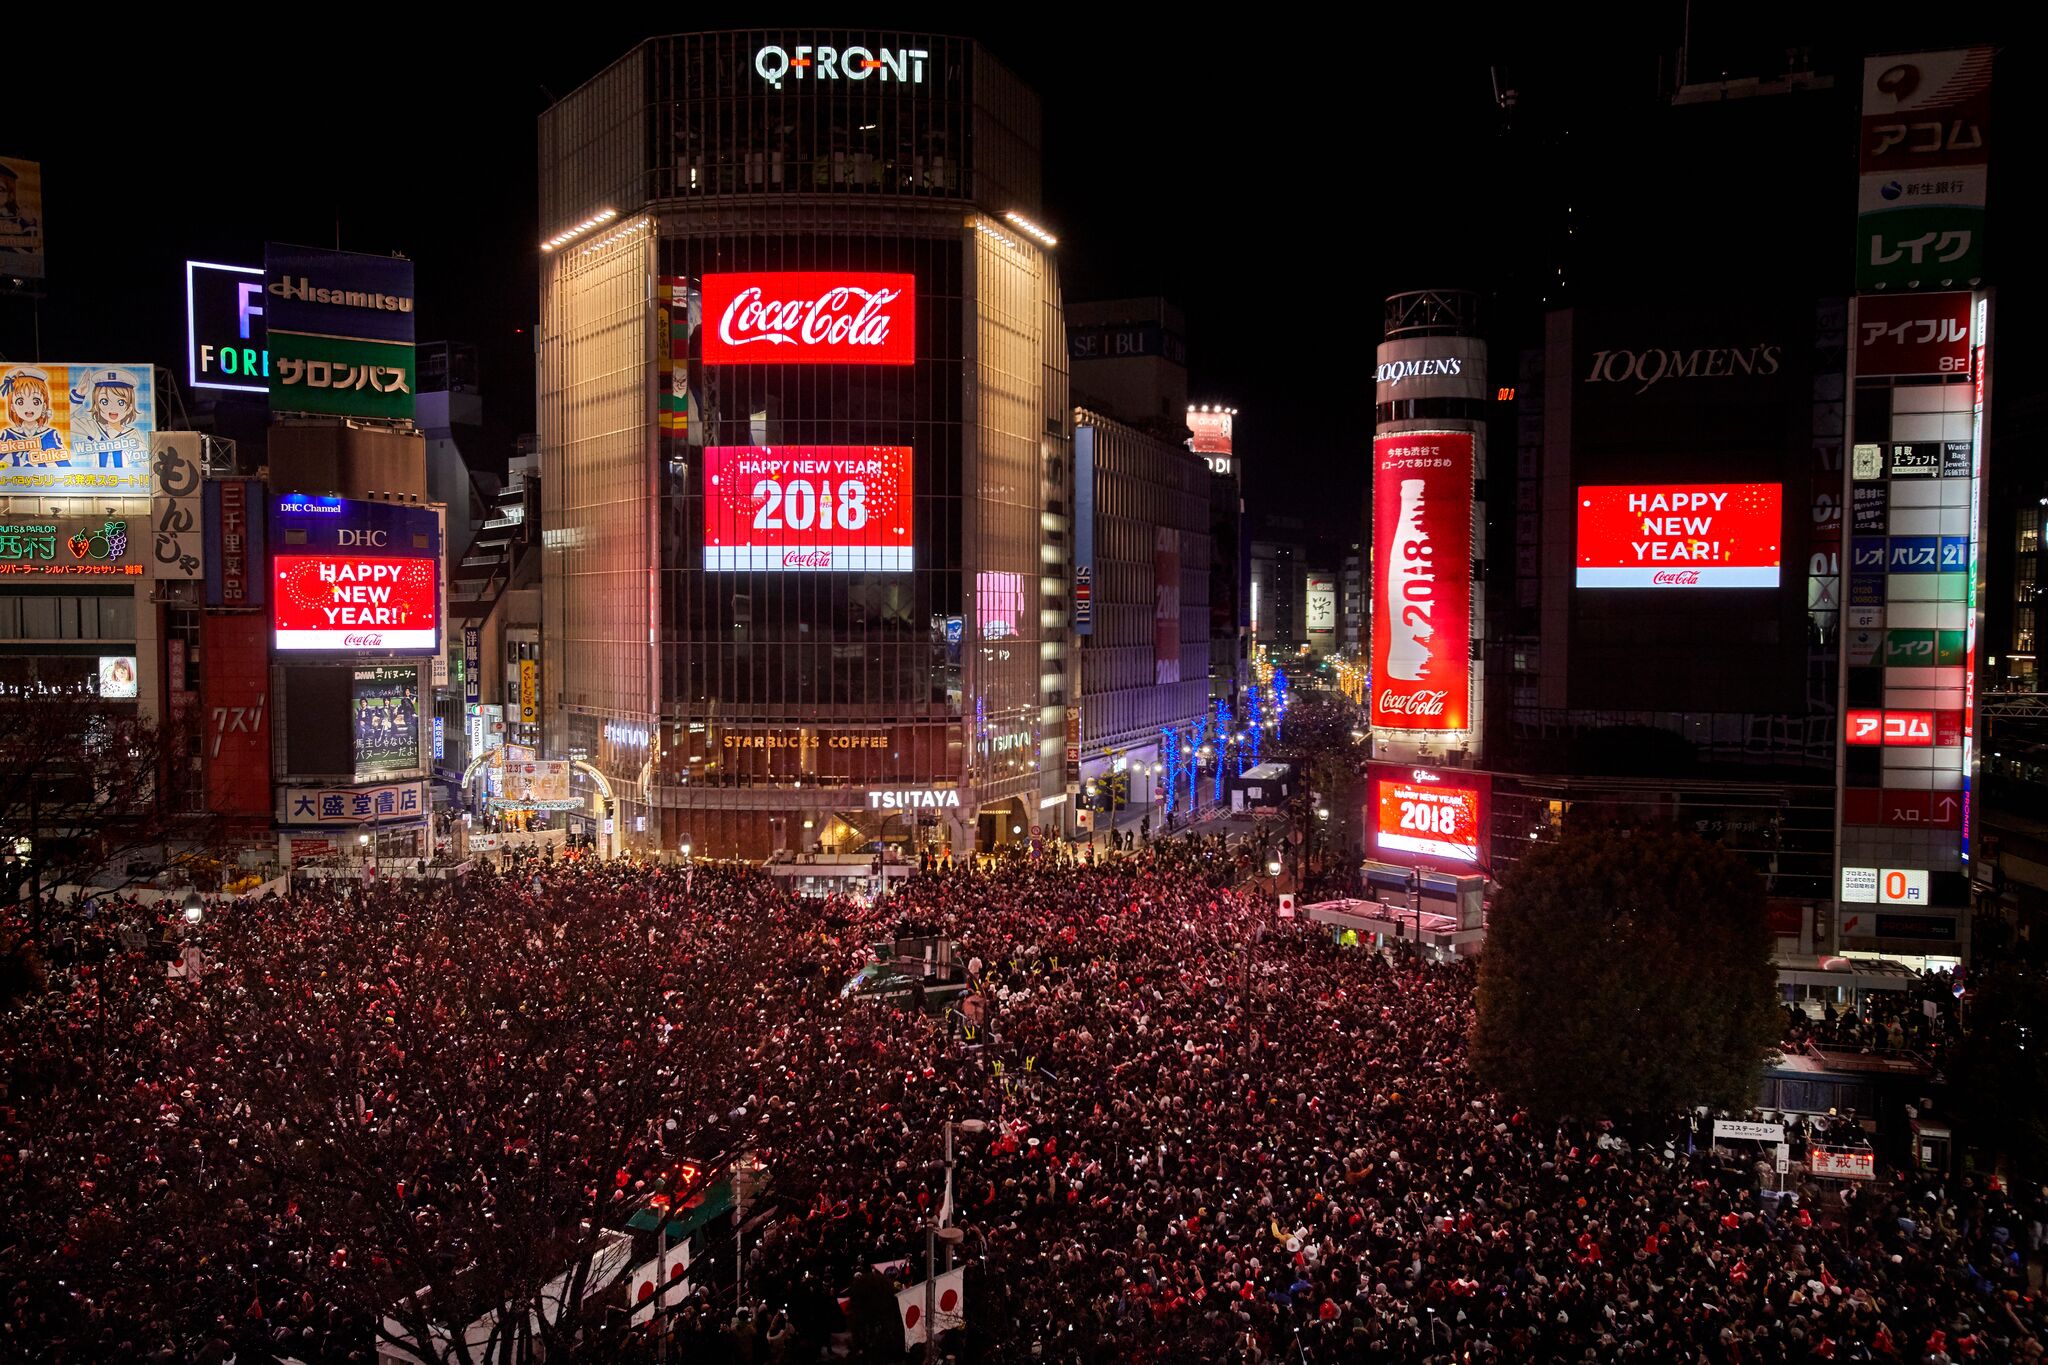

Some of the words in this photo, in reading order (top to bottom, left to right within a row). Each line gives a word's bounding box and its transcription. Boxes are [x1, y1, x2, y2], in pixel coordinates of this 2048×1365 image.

[755, 45, 928, 90] QFRONT
[1871, 120, 1982, 155] アコム
[1907, 180, 1964, 195] 新生銀行
[1871, 230, 1971, 265] レイク
[268, 275, 413, 313] Hisamitsu
[719, 286, 901, 346] Coca-Cola
[1862, 319, 1967, 346] アイフル
[1938, 356, 1965, 371] 8F
[277, 356, 410, 395] サロンパス
[74, 438, 137, 453] Watanabe
[1387, 446, 1440, 458] 今年も渋谷で
[1894, 446, 1913, 456] 買取
[29, 449, 69, 462] Chika
[1381, 458, 1452, 470] #コークであけおめ
[1893, 455, 1938, 466] エージェント
[1951, 452, 1966, 460] Bag
[739, 460, 790, 475] HAPPY
[793, 460, 831, 475] NEW
[834, 460, 883, 475] YEAR!
[153, 446, 201, 576] もんじゃ
[281, 503, 302, 512] DHC
[303, 504, 341, 513] Channel
[753, 479, 867, 530] 2018
[1628, 492, 1728, 512] HAPPY
[26, 525, 57, 533] PARLOR
[1643, 517, 1712, 536] NEW
[223, 487, 242, 599] 三千里薬品
[338, 529, 387, 547] DHC
[782, 549, 833, 568] Coca-Cola
[1631, 541, 1720, 560] YEAR!
[319, 564, 402, 583] HAPPY
[1653, 570, 1701, 585] Coca-Cola
[333, 586, 391, 603] NEW
[1076, 566, 1090, 622] SEIBU
[323, 607, 398, 625] YEAR!
[1859, 616, 1873, 625] 6F
[344, 633, 382, 646] Coca-Cola
[1888, 639, 1934, 656] レイク
[466, 631, 478, 697] 洋服の青山
[355, 671, 376, 680] DMM
[384, 670, 416, 679] バヌーシー
[1379, 689, 1448, 716] Coca-Cola
[211, 691, 265, 759] クスリ
[1856, 718, 1930, 737] アコム
[723, 735, 819, 749] STARBUCKS
[828, 735, 888, 749] COFFEE
[1413, 770, 1440, 784] Glico
[294, 789, 417, 817] 大盛堂書店
[869, 790, 960, 809] TSUTAYA
[1400, 801, 1455, 834] 2018
[1892, 808, 1920, 821] 入口
[1722, 1124, 1776, 1134] エコステーション
[1815, 1152, 1871, 1169] 警戒中
